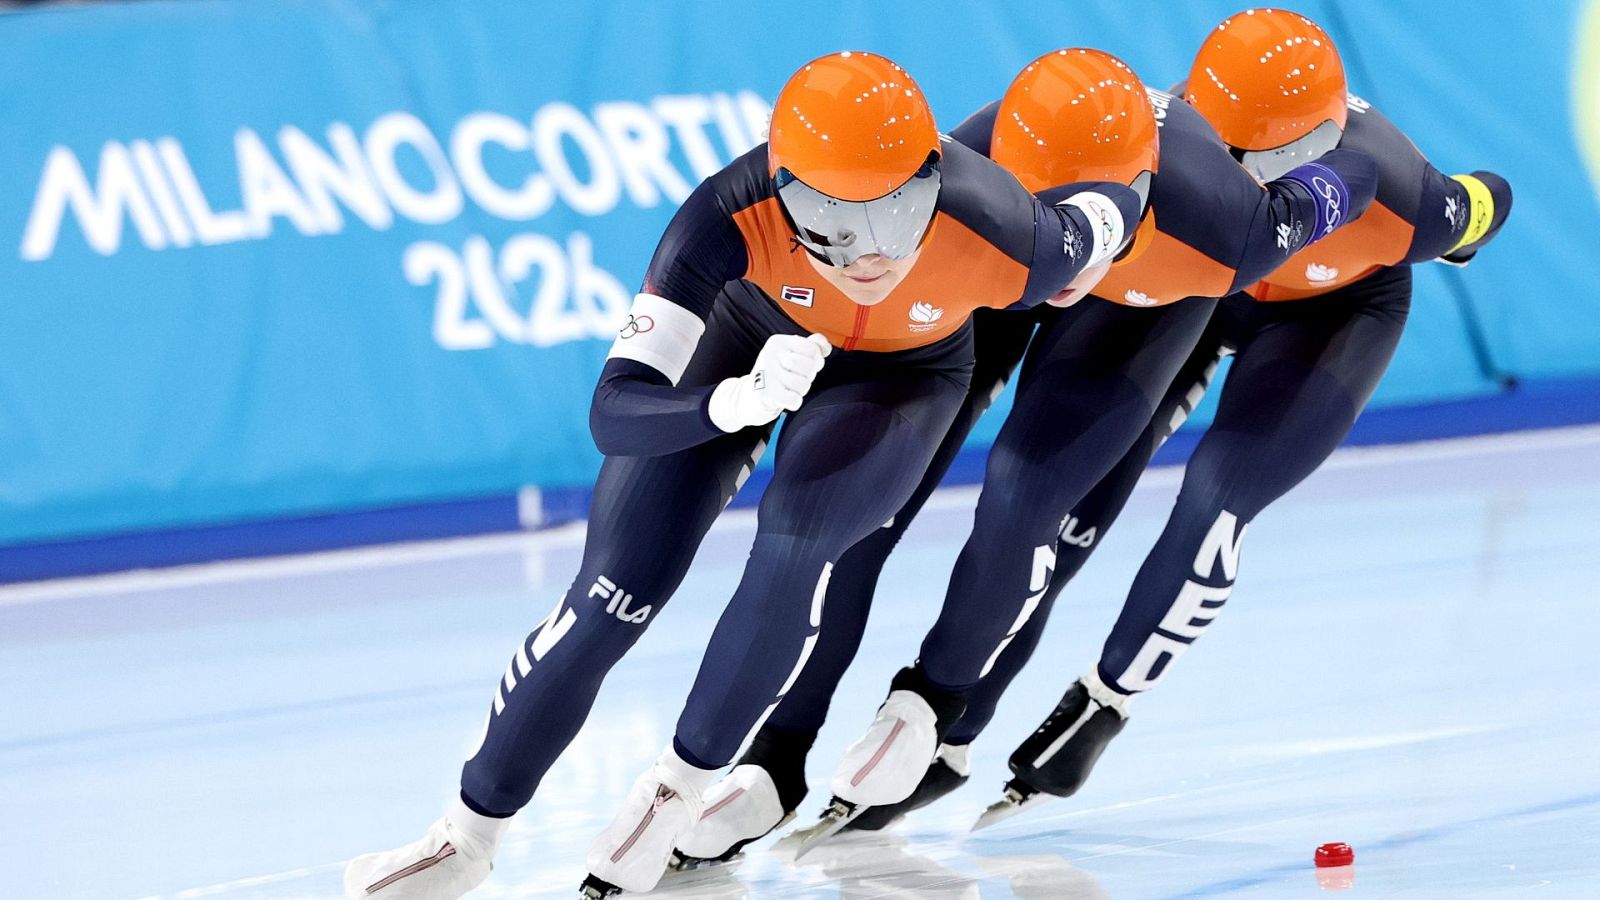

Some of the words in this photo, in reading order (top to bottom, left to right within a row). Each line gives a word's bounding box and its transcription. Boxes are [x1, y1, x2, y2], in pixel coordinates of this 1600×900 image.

[20, 112, 464, 262] MILANO
[1058, 513, 1097, 548] ILA
[588, 575, 652, 624] FILA
[1115, 509, 1249, 693] NED
